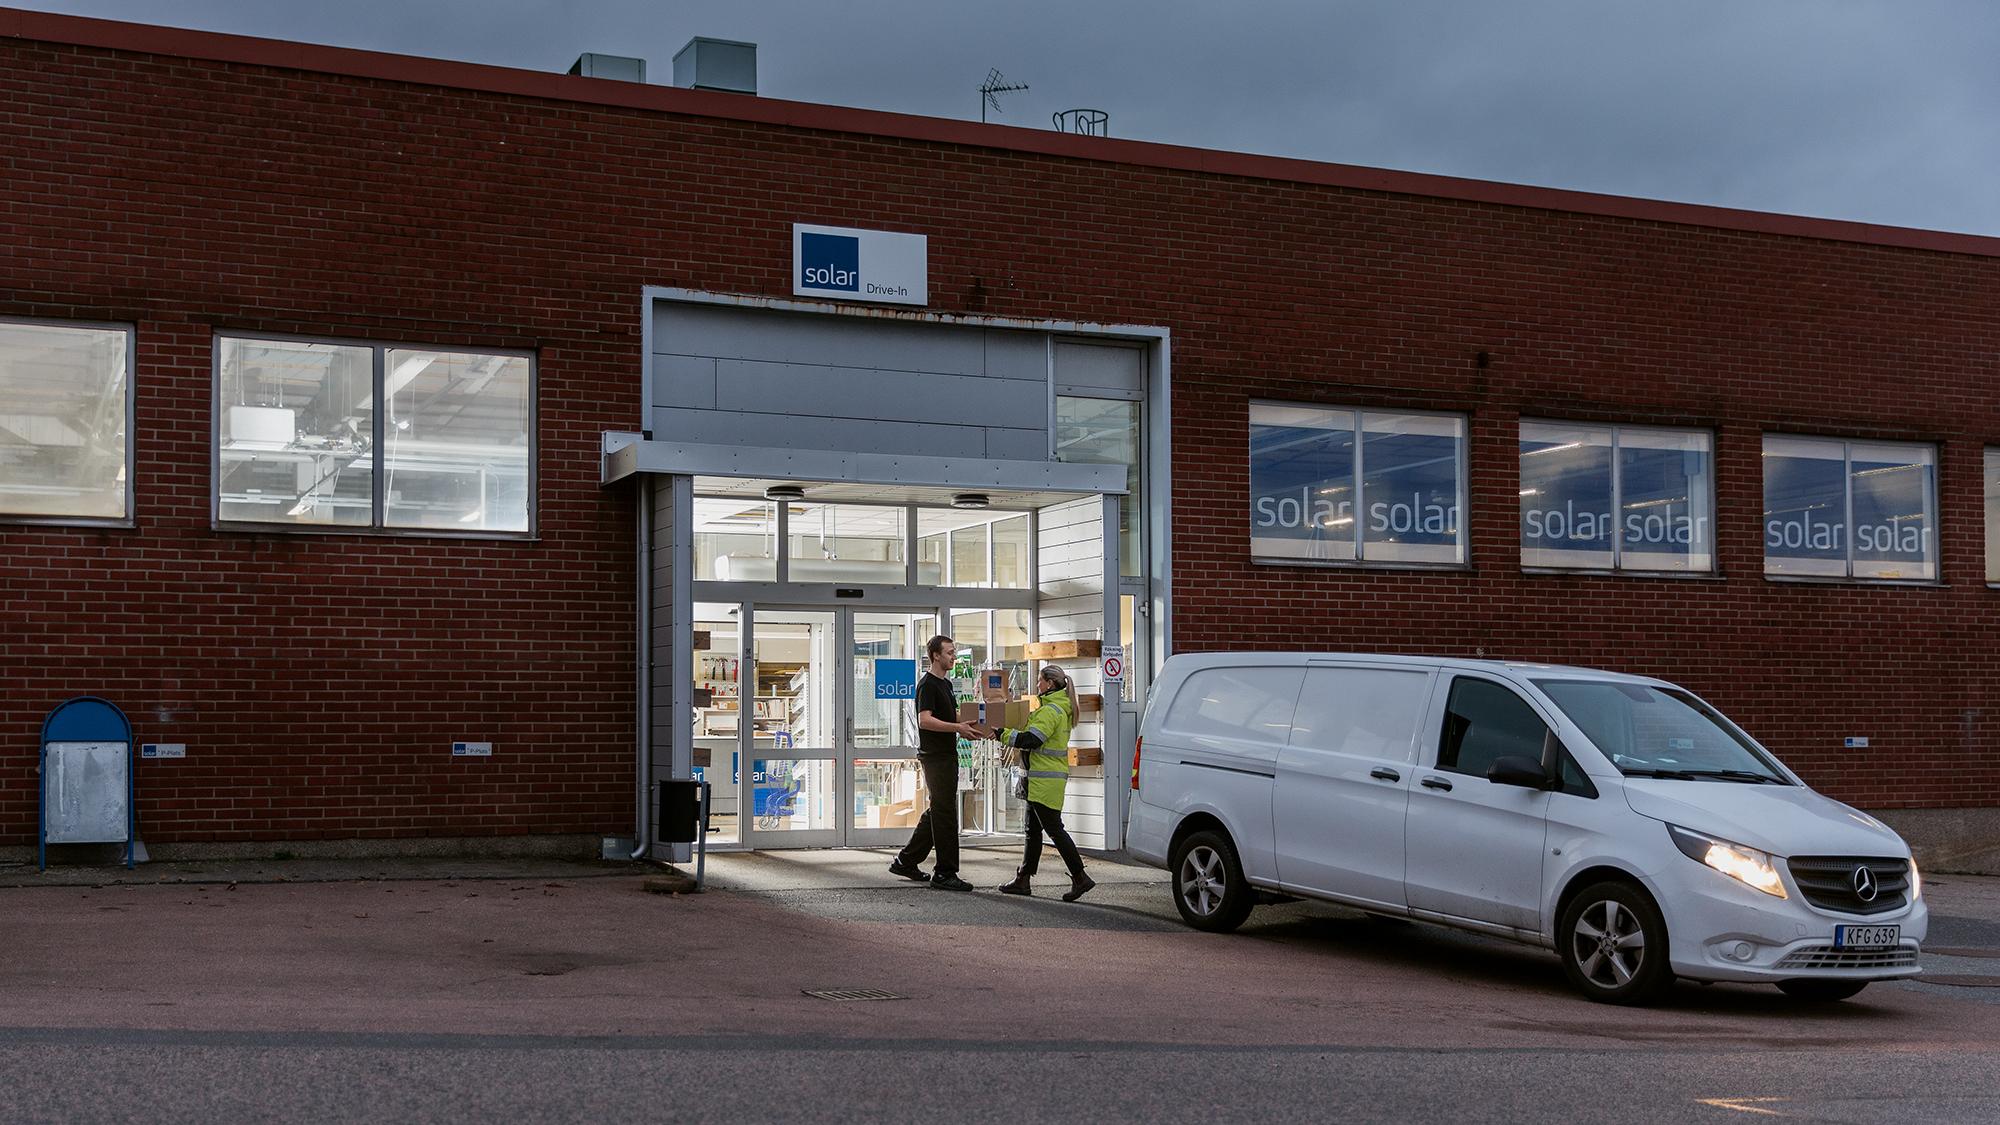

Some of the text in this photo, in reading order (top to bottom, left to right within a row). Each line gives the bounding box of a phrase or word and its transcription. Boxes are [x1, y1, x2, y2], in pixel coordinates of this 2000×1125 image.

[805, 264, 857, 286] solar
[866, 283, 908, 296] Drive-In
[1257, 486, 1460, 533] solar solar
[1526, 500, 1708, 543] solar solar
[1767, 511, 1931, 552] solar solar
[877, 680, 914, 695] solar
[1847, 928, 1895, 945] KFG 639
